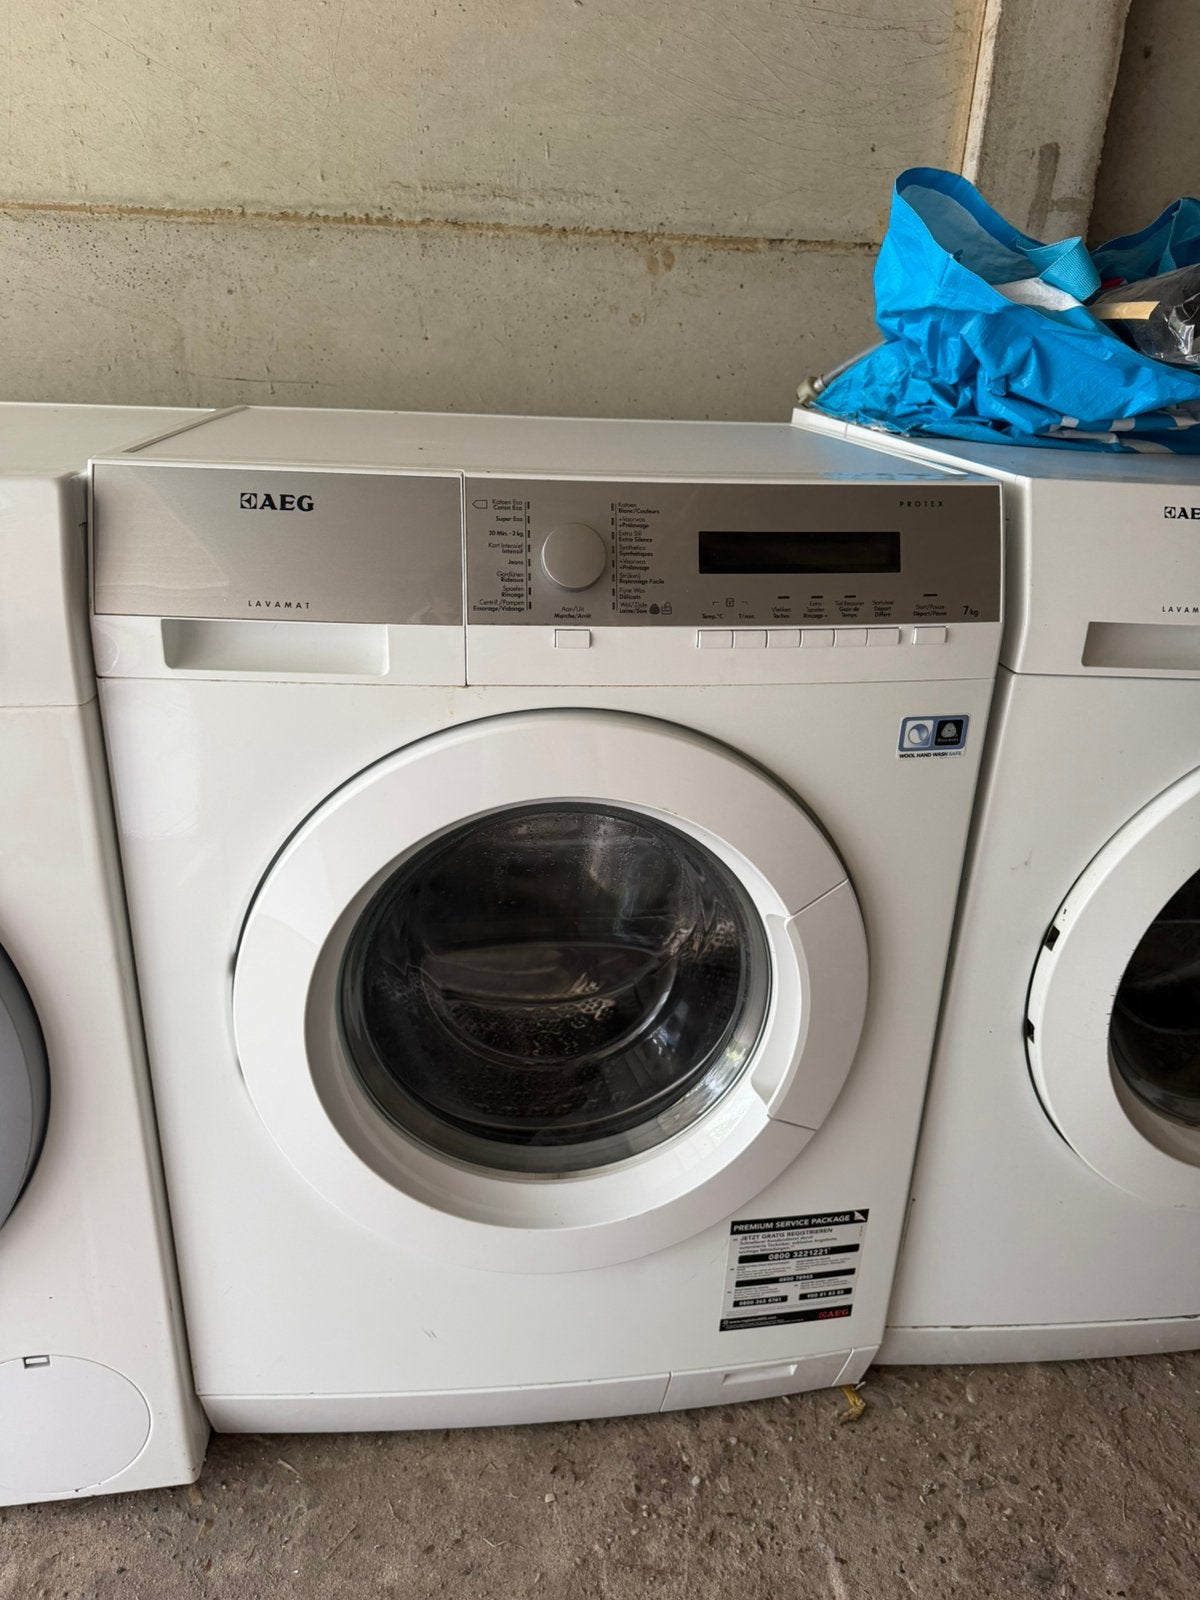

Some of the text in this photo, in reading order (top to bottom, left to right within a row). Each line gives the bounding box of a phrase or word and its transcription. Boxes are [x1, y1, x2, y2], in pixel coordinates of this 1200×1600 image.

[259, 493, 314, 512] AEG
[899, 500, 944, 508] PROTEX
[248, 600, 310, 609] LAVAMAT
[733, 1214, 851, 1232] PREMIUM SERVICE PACKAGE
[740, 1233, 760, 1241] JETZT
[761, 1231, 785, 1240] GRATIS
[786, 1227, 833, 1237] REGISTRIEREN
[768, 1251, 790, 1260] 0800
[827, 1308, 849, 1318] AEG
